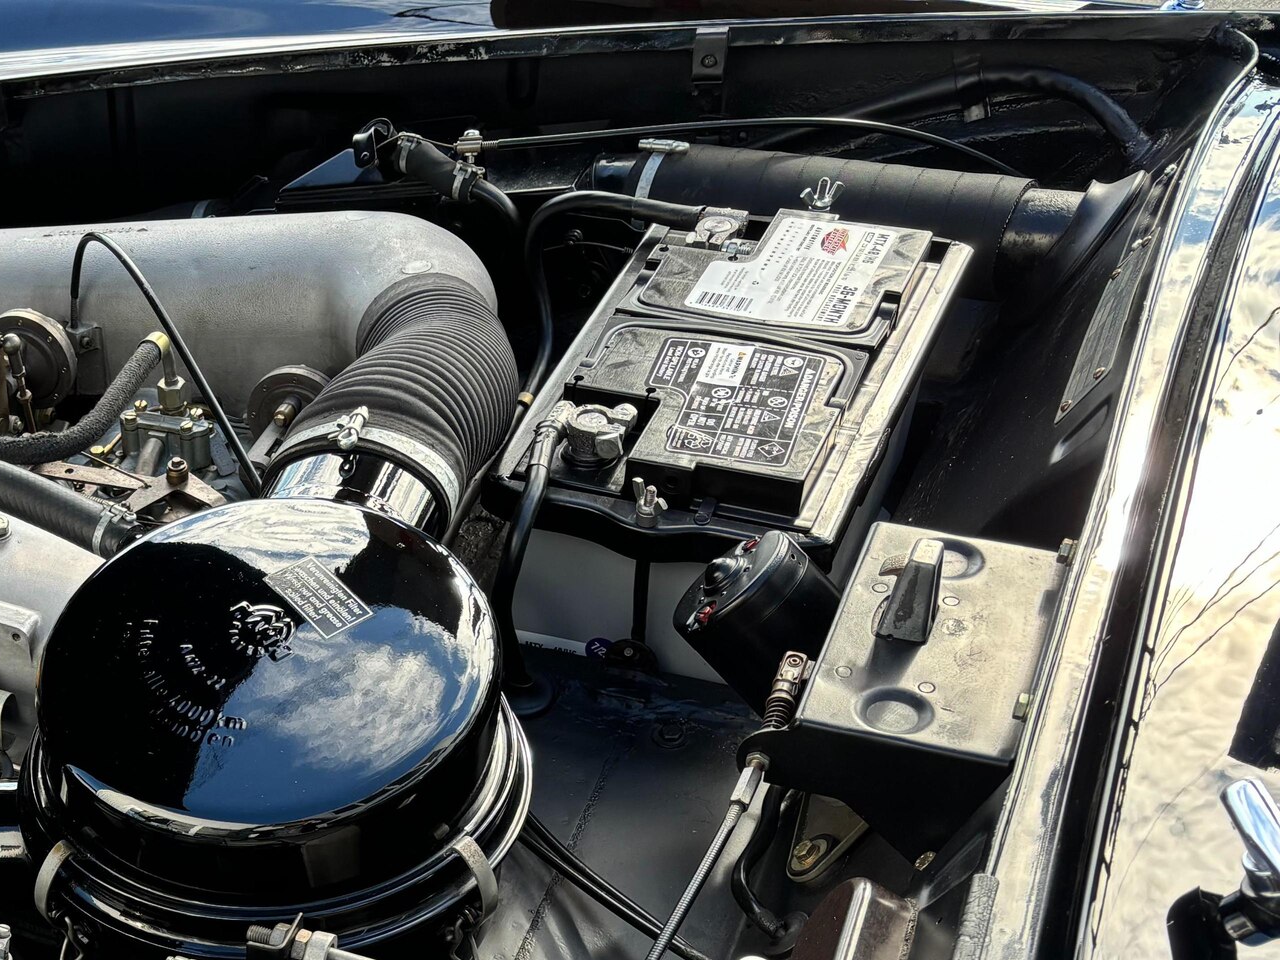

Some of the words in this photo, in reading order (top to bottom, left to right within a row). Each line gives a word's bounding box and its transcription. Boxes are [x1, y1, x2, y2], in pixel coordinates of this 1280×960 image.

[821, 285, 859, 324] 36-MONTH
[283, 586, 307, 606] soiled
[299, 602, 323, 621] filter!
[292, 564, 323, 590] waschen
[316, 586, 334, 600] und
[326, 597, 357, 622] einölen!
[303, 561, 350, 602] Verunreinigten
[343, 598, 365, 615] Filter
[307, 594, 326, 608] and
[316, 606, 344, 629] grease
[217, 710, 248, 731] km
